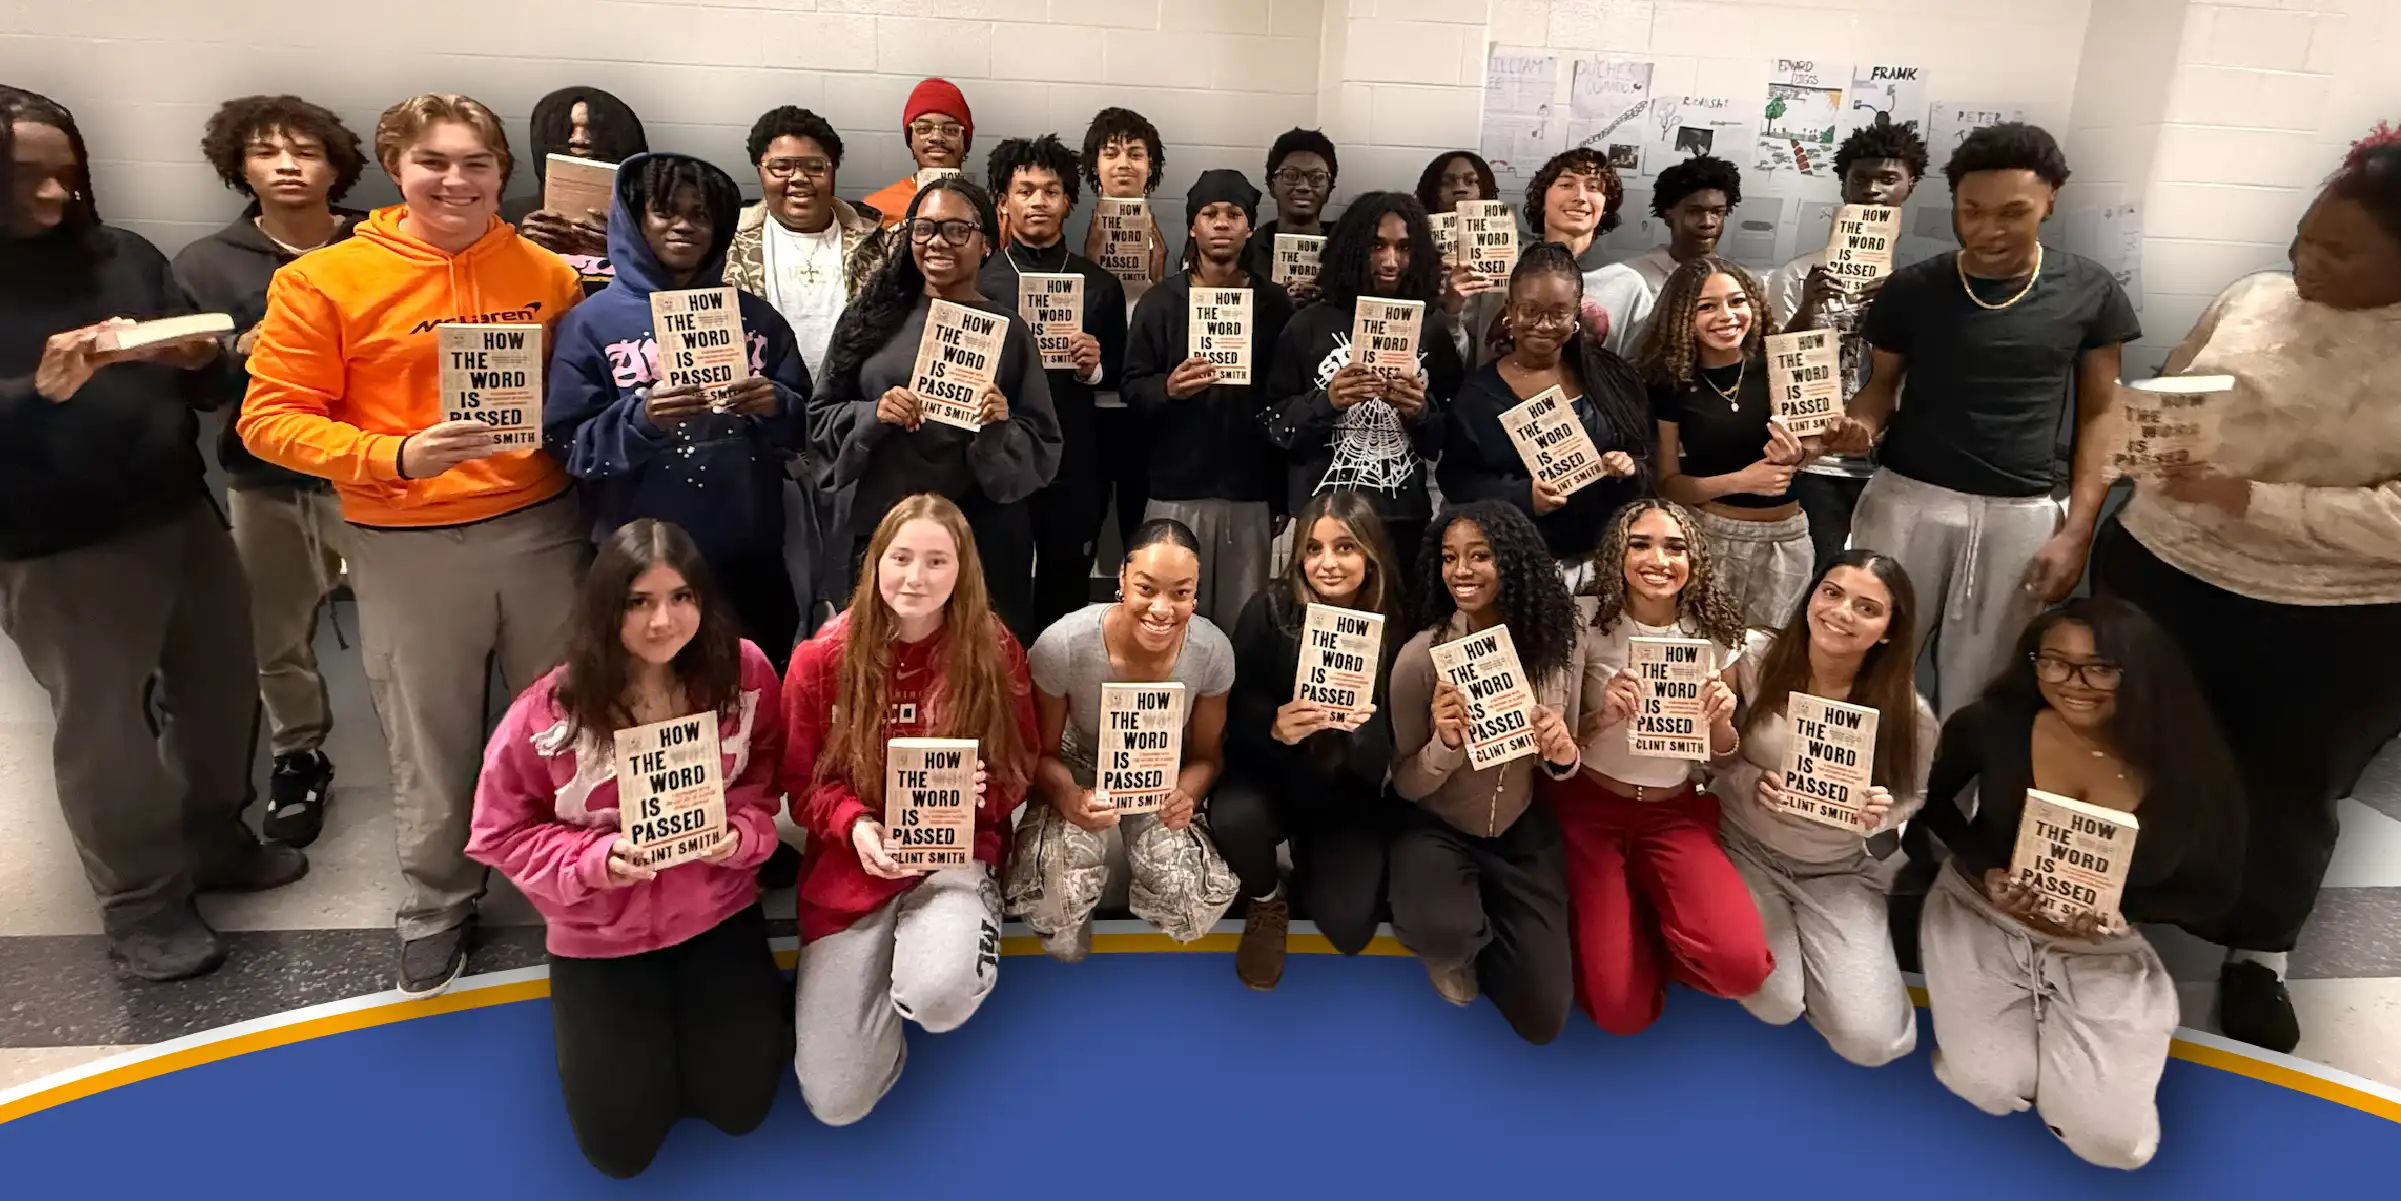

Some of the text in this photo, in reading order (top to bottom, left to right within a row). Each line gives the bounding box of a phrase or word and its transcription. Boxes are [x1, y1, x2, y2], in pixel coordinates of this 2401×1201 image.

[1871, 66, 1918, 81] FRANK
[1119, 204, 1141, 215] HOW
[1484, 204, 1509, 217] HOW
[1862, 209, 1891, 222] HOW
[1102, 216, 1121, 229] THE
[1443, 216, 1458, 228] HO
[1467, 218, 1486, 232] THE
[1840, 220, 1864, 235] THE
[1111, 231, 1141, 242] WORD
[1476, 232, 1509, 246] WORD
[1848, 235, 1885, 250] WORD
[1105, 242, 1116, 255] IS
[1297, 240, 1319, 252] HOW
[1470, 248, 1481, 259] IS
[1838, 249, 1852, 261] IS
[1100, 255, 1140, 269] PASSED
[1282, 252, 1299, 263] THE
[1478, 260, 1505, 273] SSED
[1122, 273, 1146, 281] SMITH
[1289, 265, 1317, 276] WORD
[1047, 280, 1073, 294] HOW
[1490, 279, 1509, 287] MIT
[688, 292, 723, 312] HOW
[1027, 294, 1049, 308] THE
[1215, 292, 1242, 305] HOW
[664, 313, 696, 332] THE
[1038, 309, 1072, 322] WORD
[1196, 307, 1218, 320] THE
[1385, 306, 1413, 321] HOW
[961, 313, 996, 336] HOW
[1031, 322, 1044, 335] IS
[1207, 322, 1241, 335] WORD
[1363, 319, 1387, 335] THE
[484, 332, 524, 350] HOW
[681, 329, 730, 350] WORD
[935, 323, 963, 345] THE
[1201, 336, 1212, 350] IS
[1798, 333, 1825, 351] HOW
[1039, 337, 1069, 350] SSED
[1372, 336, 1408, 351] WORD
[451, 352, 488, 370] THE
[676, 352, 694, 368] IS
[943, 345, 985, 371] WORD
[1362, 350, 1376, 363] IS
[1778, 353, 1804, 369] THE
[670, 365, 732, 387] PASSED
[930, 360, 946, 378] IS
[1220, 371, 1247, 379] SMITH
[1791, 365, 1829, 383] WORD
[470, 371, 525, 390] WORD
[917, 376, 974, 403] PASSED
[460, 392, 481, 408] IS
[1786, 385, 1801, 400] IS
[1527, 395, 1556, 419] HOW
[1781, 397, 1830, 416] PASSED
[2124, 405, 2161, 423] THE
[1516, 420, 1543, 442] THE
[1787, 420, 1810, 432] LINT
[491, 432, 535, 445] SMITH
[1534, 423, 1573, 449] WORD
[1536, 451, 1553, 466] IS
[1537, 451, 1586, 482] PASSED
[1573, 463, 1601, 484] SMITH
[1336, 616, 1370, 637] HOW
[1311, 629, 1339, 650] THE
[1463, 635, 1498, 661] HOW
[1322, 650, 1364, 672] WORD
[1665, 646, 1698, 663] HOW
[1311, 666, 1326, 684] IS
[1447, 663, 1479, 686] THE
[1641, 663, 1668, 680] THE
[1300, 683, 1355, 707] PASSED
[1468, 672, 1514, 701] WORD
[1654, 681, 1697, 699] WORD
[1137, 692, 1170, 710] HOW
[1645, 698, 1661, 714] IS
[1110, 711, 1140, 730] THE
[1467, 702, 1485, 722] IS
[1824, 706, 1862, 730] HOW
[1468, 709, 1525, 744] PASSED
[1637, 715, 1693, 734] PASSED
[1797, 718, 1827, 741] THE
[659, 720, 700, 748] HOW
[1124, 731, 1168, 750] WORD
[1476, 732, 1536, 763] CLINT SMIT
[1636, 739, 1704, 754] CLINT SMITH
[1808, 740, 1856, 767] WORD
[629, 750, 667, 776] THE
[925, 751, 961, 769] HOW
[1114, 751, 1129, 769] IS
[1797, 754, 1813, 774] IS
[649, 764, 706, 794] WORD
[897, 770, 928, 788] THE
[1104, 770, 1162, 790] PASSED
[1785, 770, 1849, 803] PASSED
[912, 789, 960, 807] WORD
[640, 797, 661, 819] IS
[902, 808, 919, 826] IS
[1820, 805, 1859, 825] SMITH
[631, 808, 706, 845] PASSED
[2035, 819, 2073, 846] THE
[2071, 814, 2118, 840] HOW
[678, 831, 720, 859] SMITH
[893, 827, 955, 845] PASSED
[928, 852, 965, 864] SMITH
[2035, 855, 2056, 874] IS
[2050, 842, 2110, 874] WORD
[2020, 868, 2097, 906] PASSED
